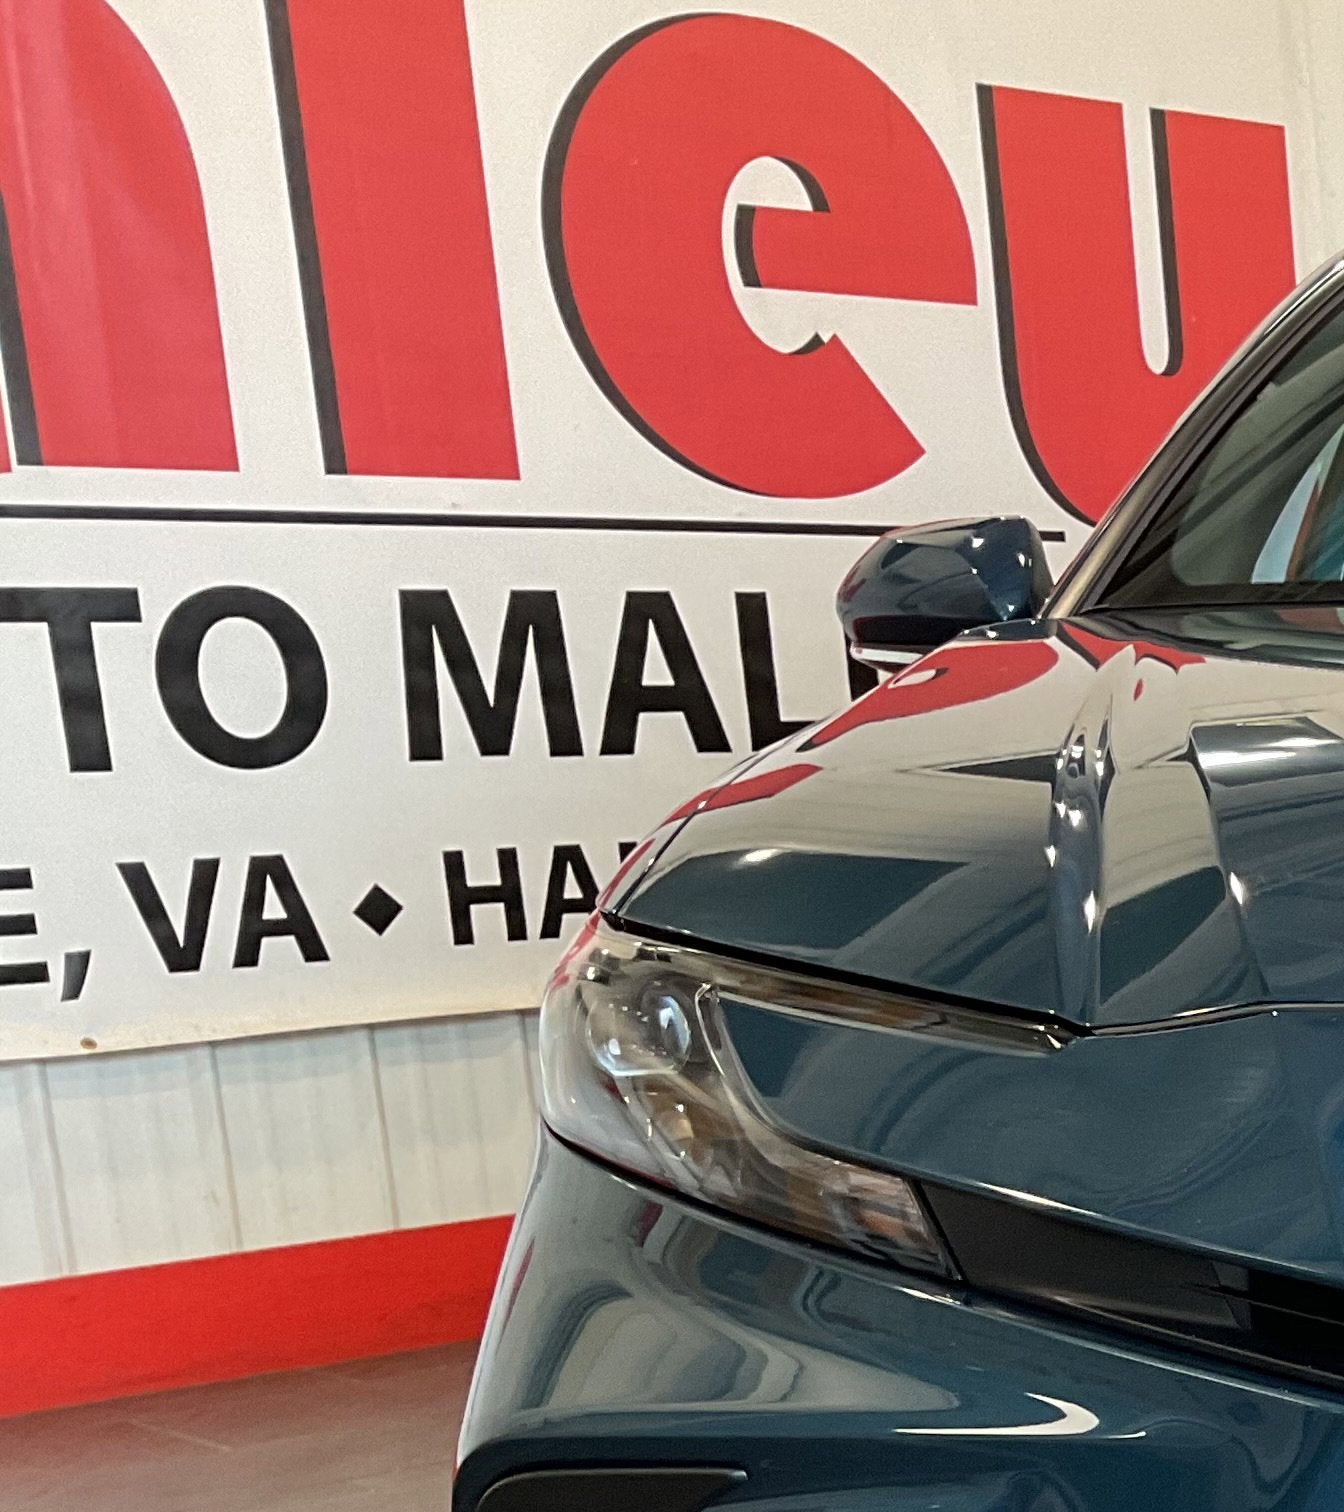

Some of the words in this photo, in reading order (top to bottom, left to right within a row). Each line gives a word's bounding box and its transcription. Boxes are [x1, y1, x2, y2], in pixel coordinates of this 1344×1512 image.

[0, 585, 328, 773] TO
[399, 586, 886, 763] MAL
[116, 853, 331, 974] VA
[442, 841, 637, 945] HA
